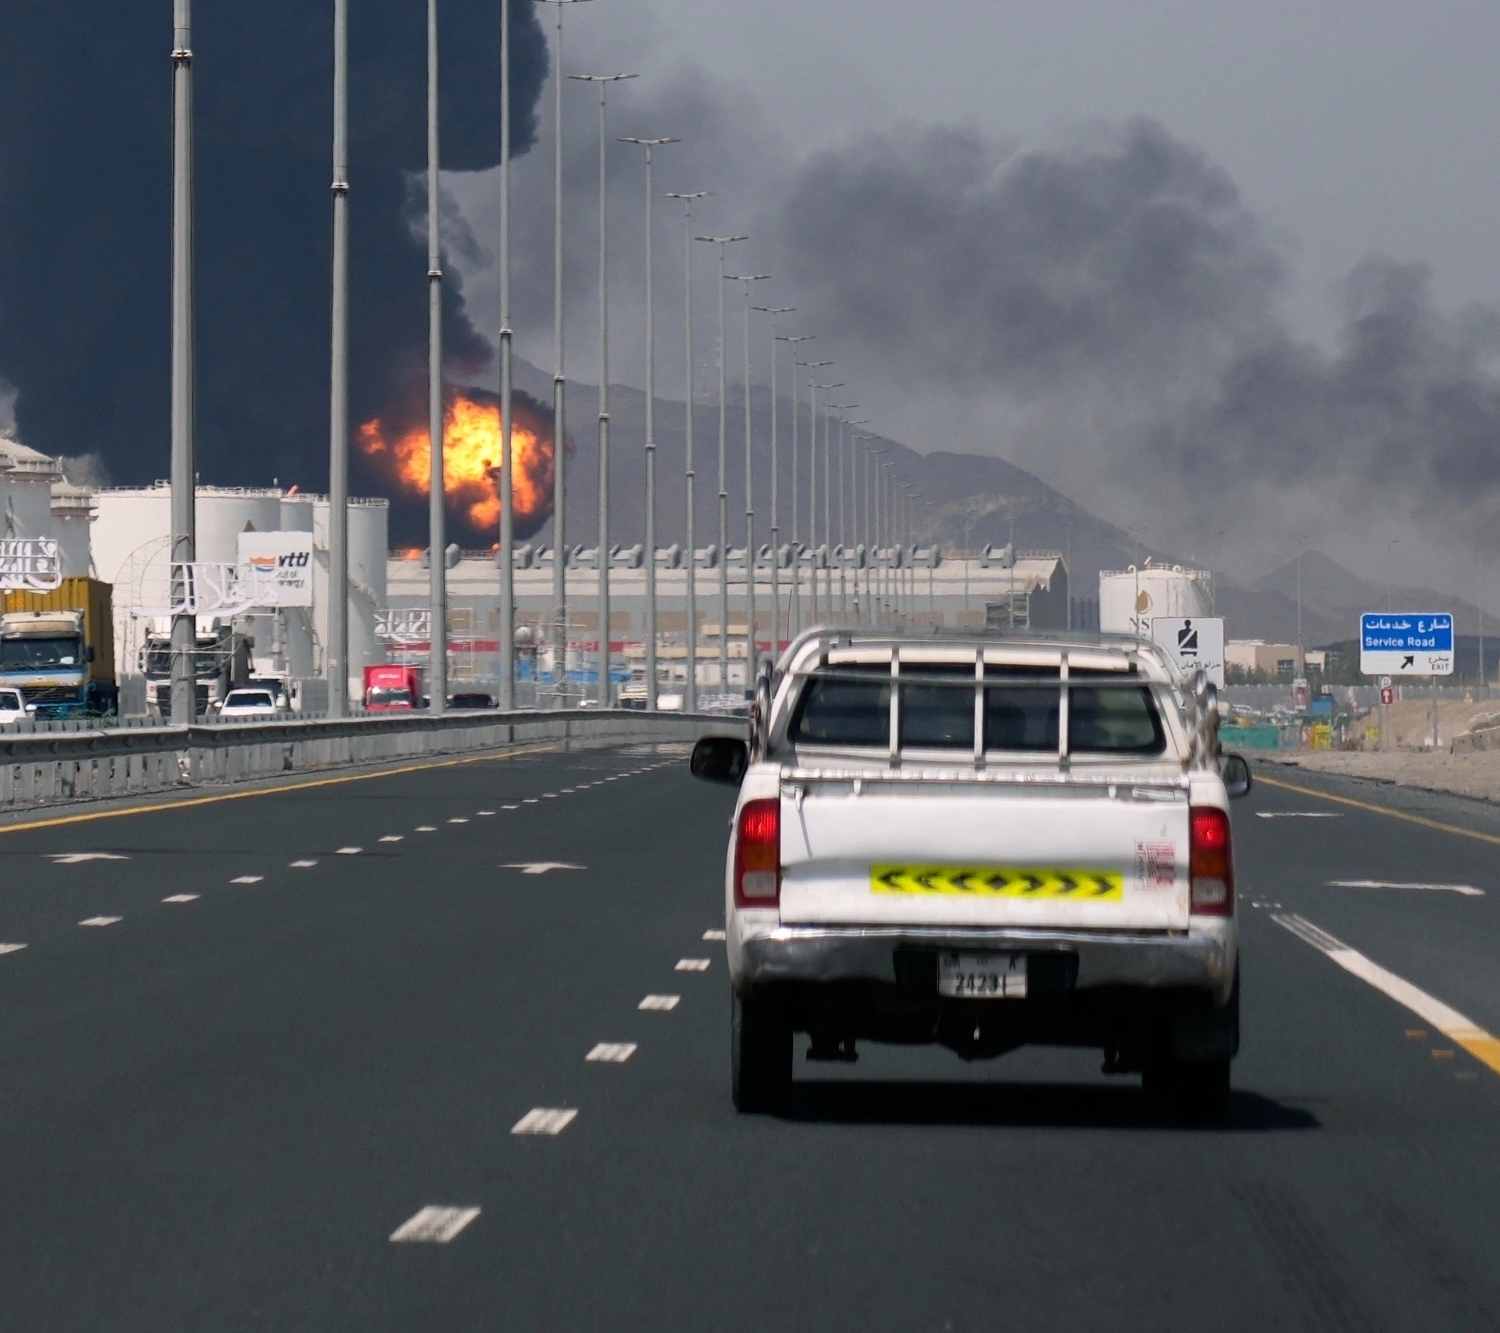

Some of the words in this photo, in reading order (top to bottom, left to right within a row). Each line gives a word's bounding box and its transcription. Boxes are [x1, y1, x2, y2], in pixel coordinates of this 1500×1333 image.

[278, 552, 310, 567] vtti
[1365, 619, 1411, 630] خدمات
[1418, 618, 1450, 633] شارع
[1365, 636, 1405, 647] Service
[1407, 636, 1436, 647] Road
[1431, 663, 1450, 671] EXIT
